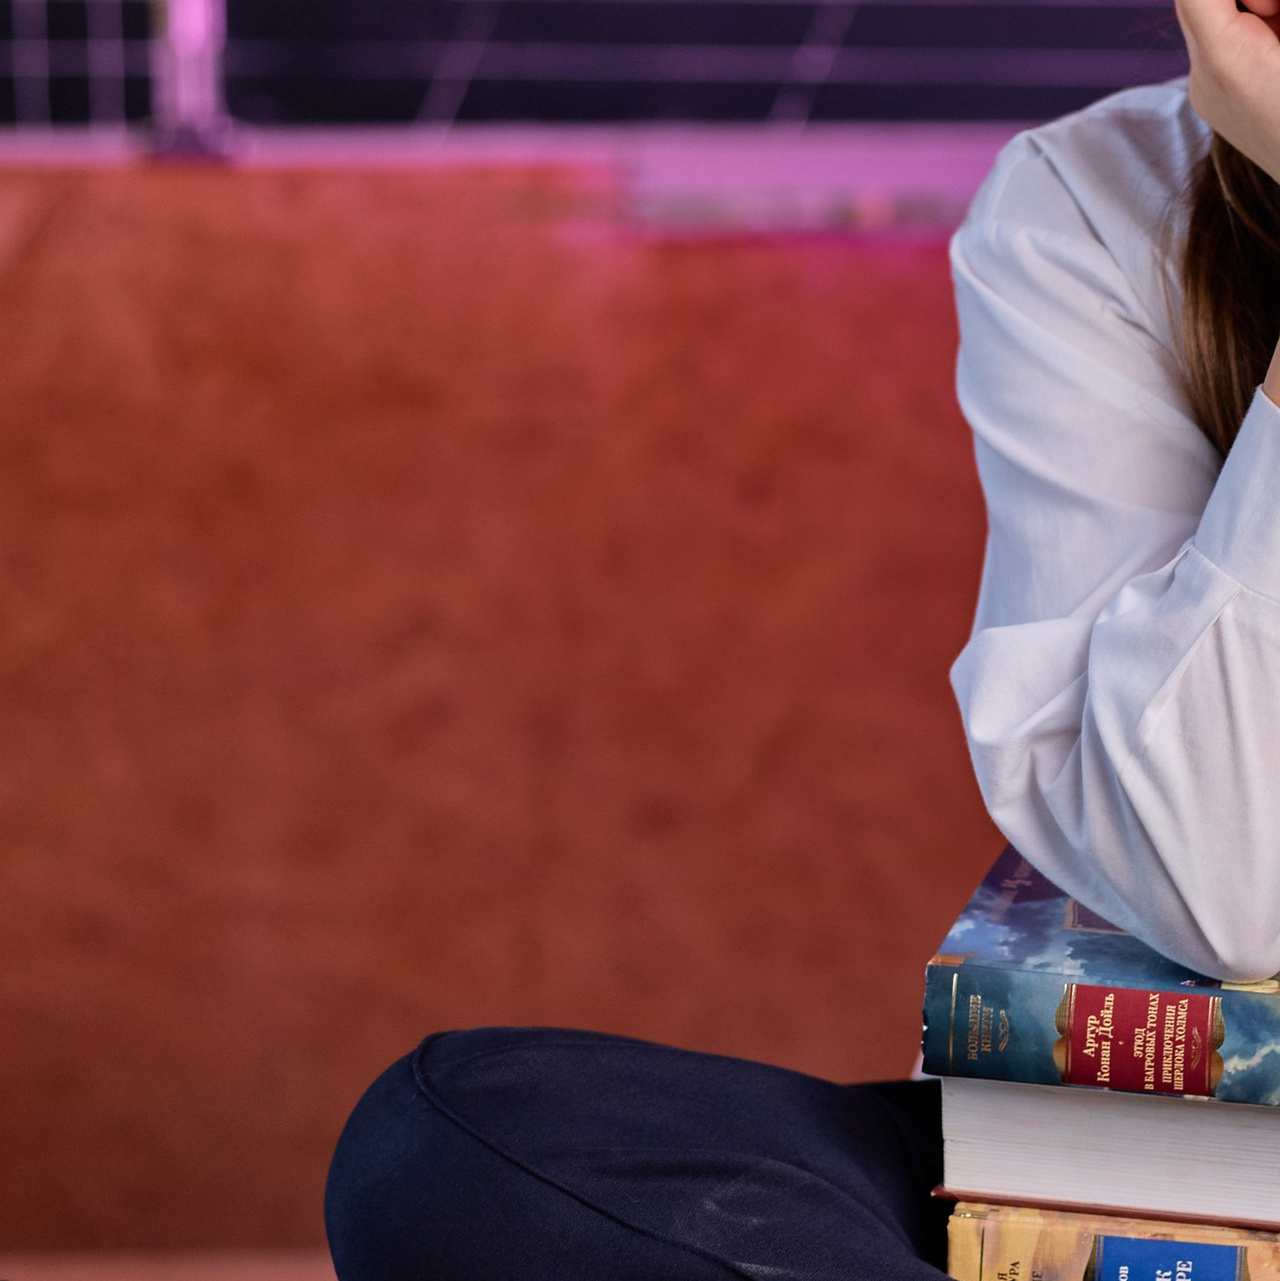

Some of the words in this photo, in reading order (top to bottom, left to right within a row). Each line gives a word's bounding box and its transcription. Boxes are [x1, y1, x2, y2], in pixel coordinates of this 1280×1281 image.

[967, 994, 982, 1061] БОЛЬШИЕ
[981, 1006, 994, 1053] КНИГИ
[1099, 993, 1115, 1039] Дойль
[1147, 993, 1160, 1029] ТОНАХ
[1175, 998, 1189, 1040] ХОЛМСА
[1082, 1014, 1100, 1058] Артур
[1133, 1027, 1146, 1058] ЭТЮД
[1145, 1030, 1157, 1081] БАГРОВЫХ
[1162, 1004, 1176, 1084] ПРИКЛЮЧЕНИЯ
[1097, 1040, 1111, 1082] Конан
[1173, 1041, 1186, 1091] ШЕРЛОКА
[1144, 1081, 1155, 1090] В
